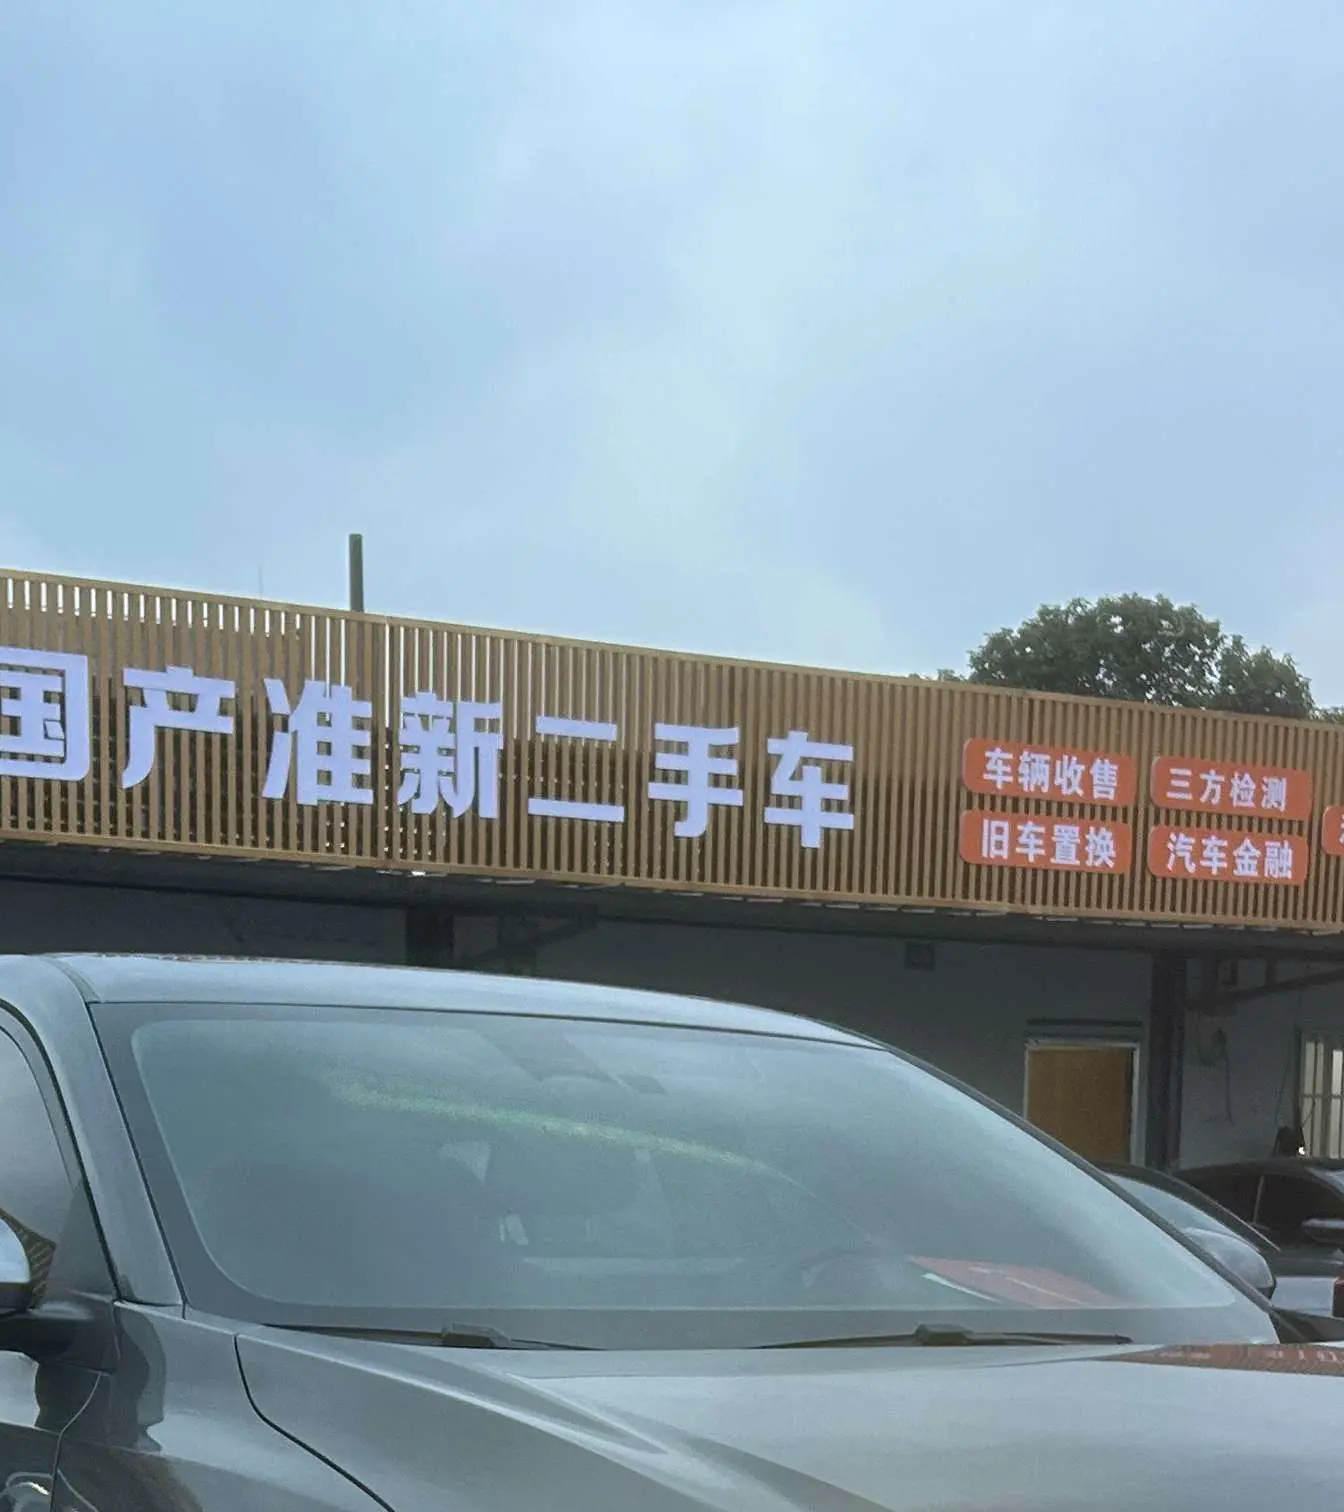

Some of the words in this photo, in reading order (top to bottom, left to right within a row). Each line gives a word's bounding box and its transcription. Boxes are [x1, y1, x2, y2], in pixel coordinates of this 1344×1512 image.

[983, 746, 1119, 801] 车辆收售
[1167, 767, 1288, 813] 三方检测
[980, 818, 1117, 869] 旧车置换
[1166, 832, 1294, 880] 汽车金融
